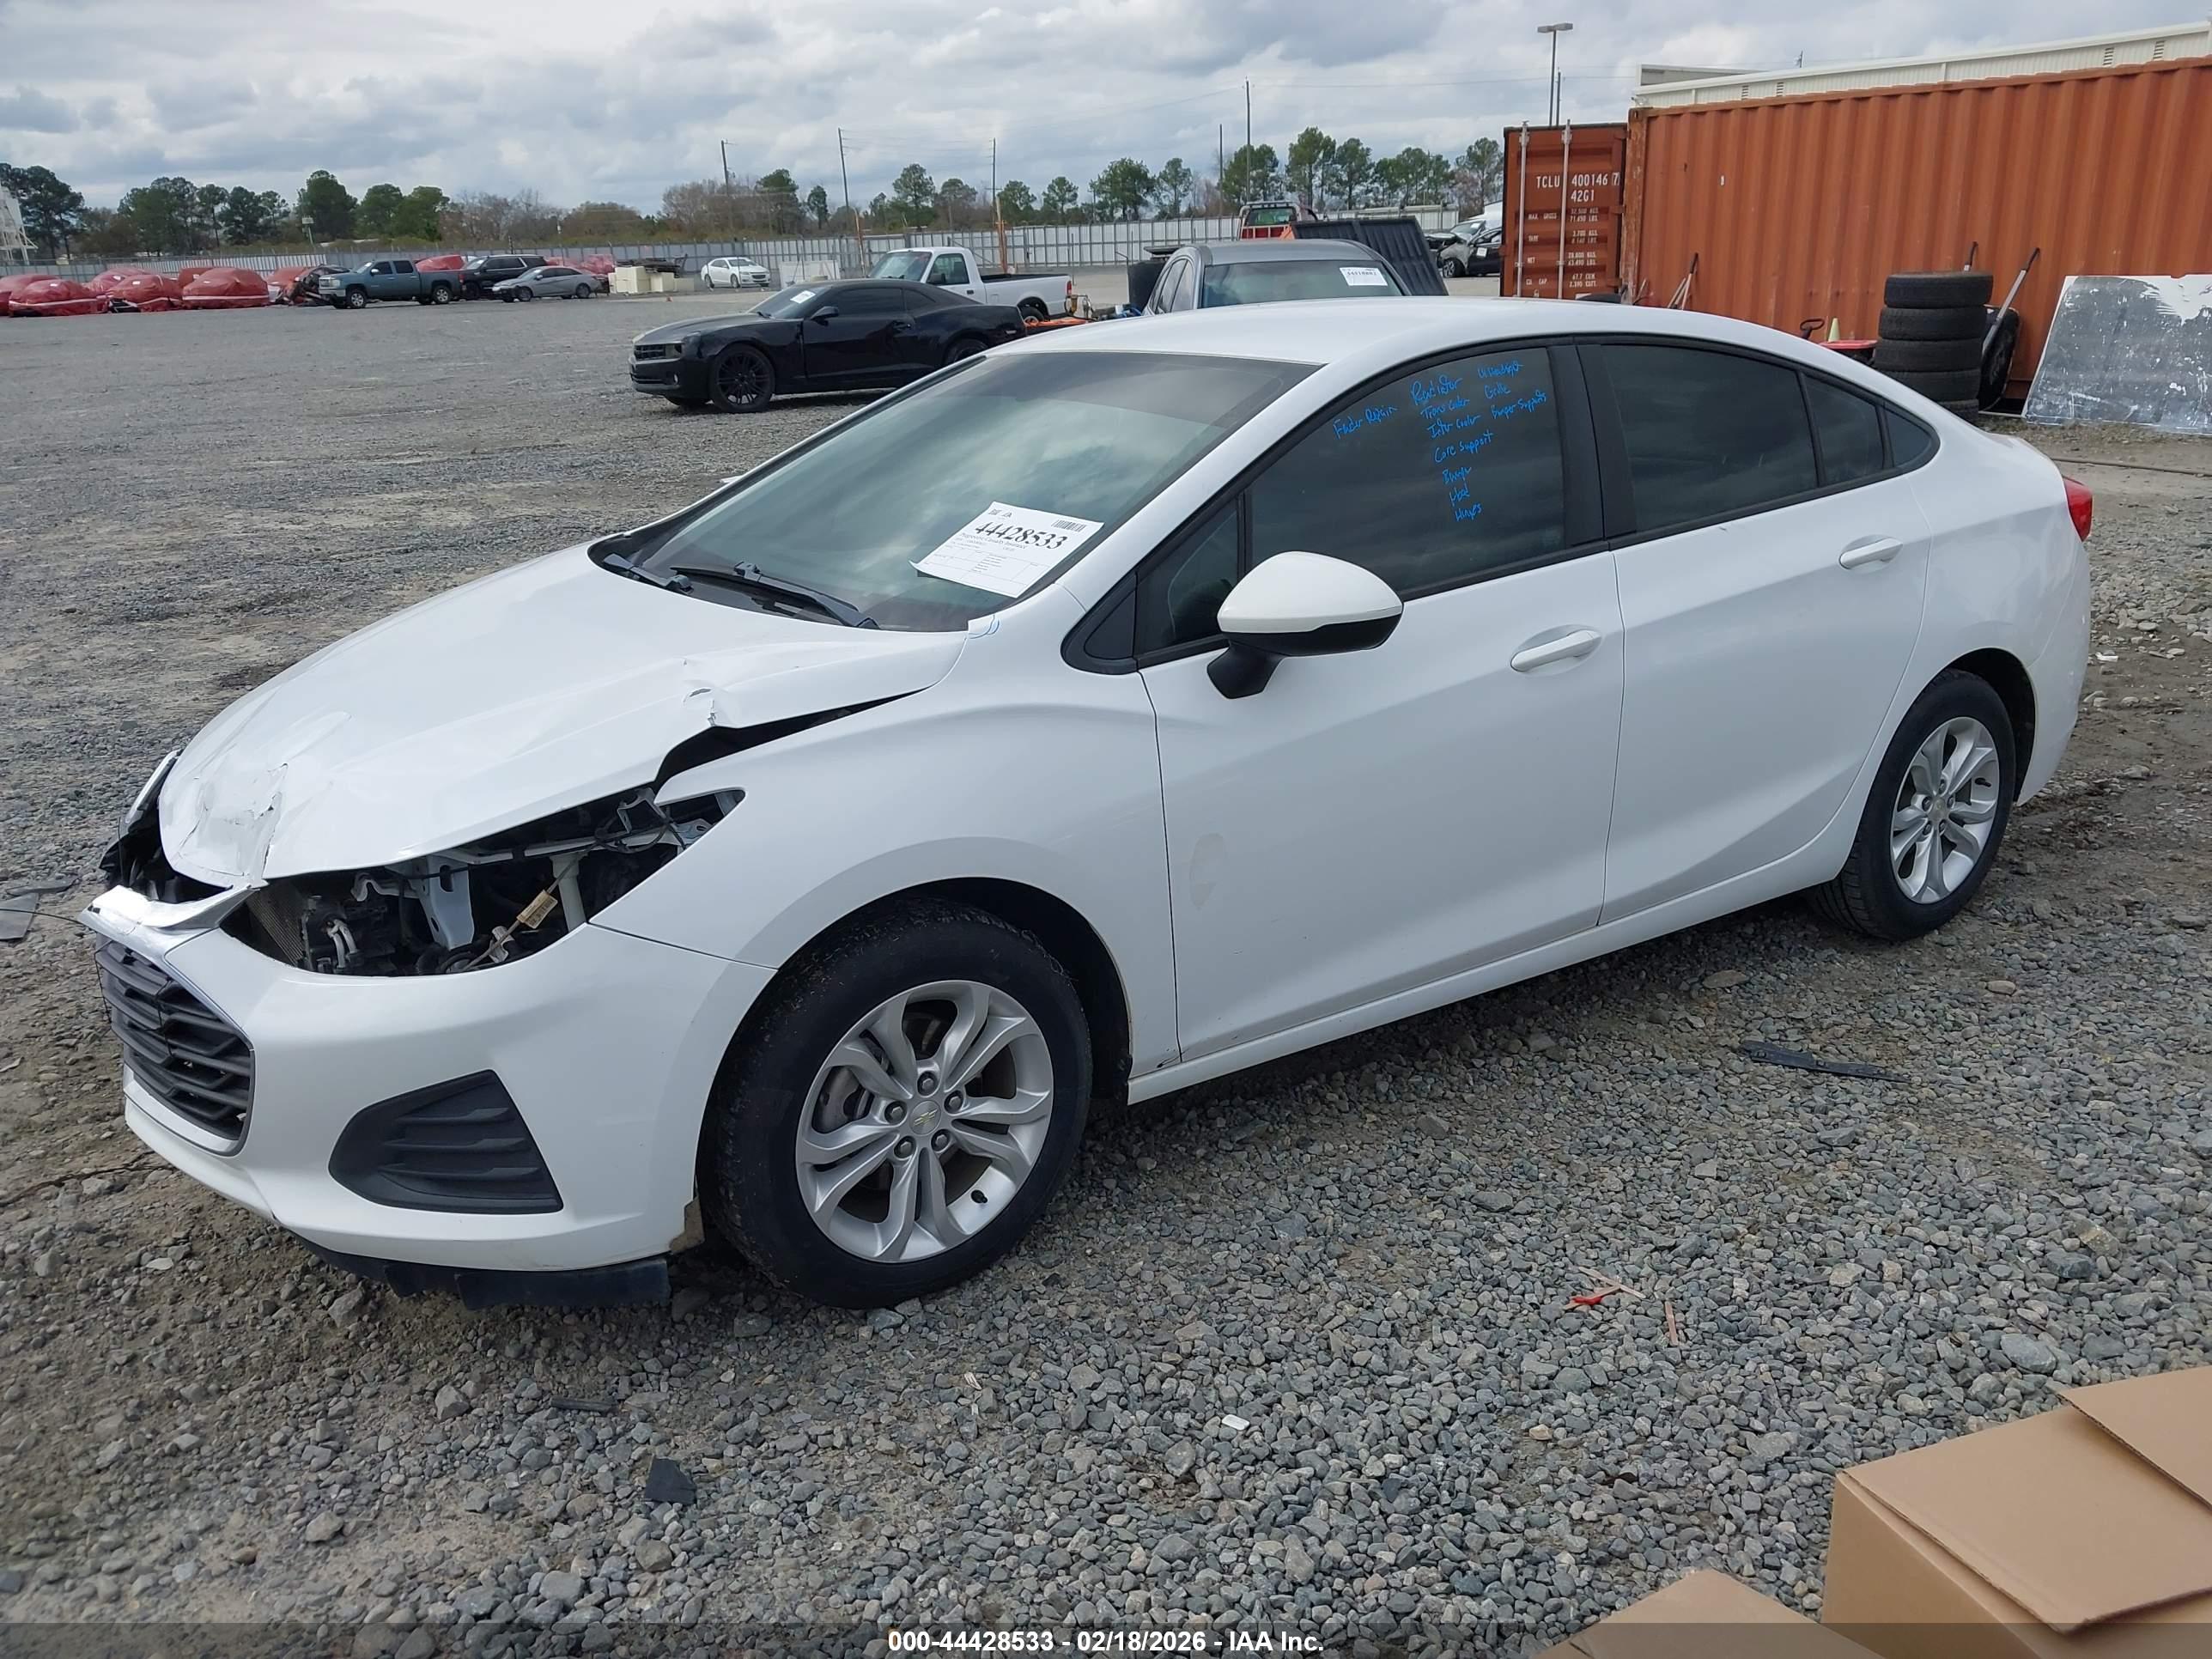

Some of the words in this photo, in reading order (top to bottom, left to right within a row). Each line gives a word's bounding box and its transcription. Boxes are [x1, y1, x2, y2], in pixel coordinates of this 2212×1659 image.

[1536, 176, 1560, 189] TCLU
[1571, 174, 1607, 186] 400146
[1571, 190, 1594, 203] 42G1
[1460, 429, 1494, 454] Support
[975, 521, 1068, 550] 44428533
